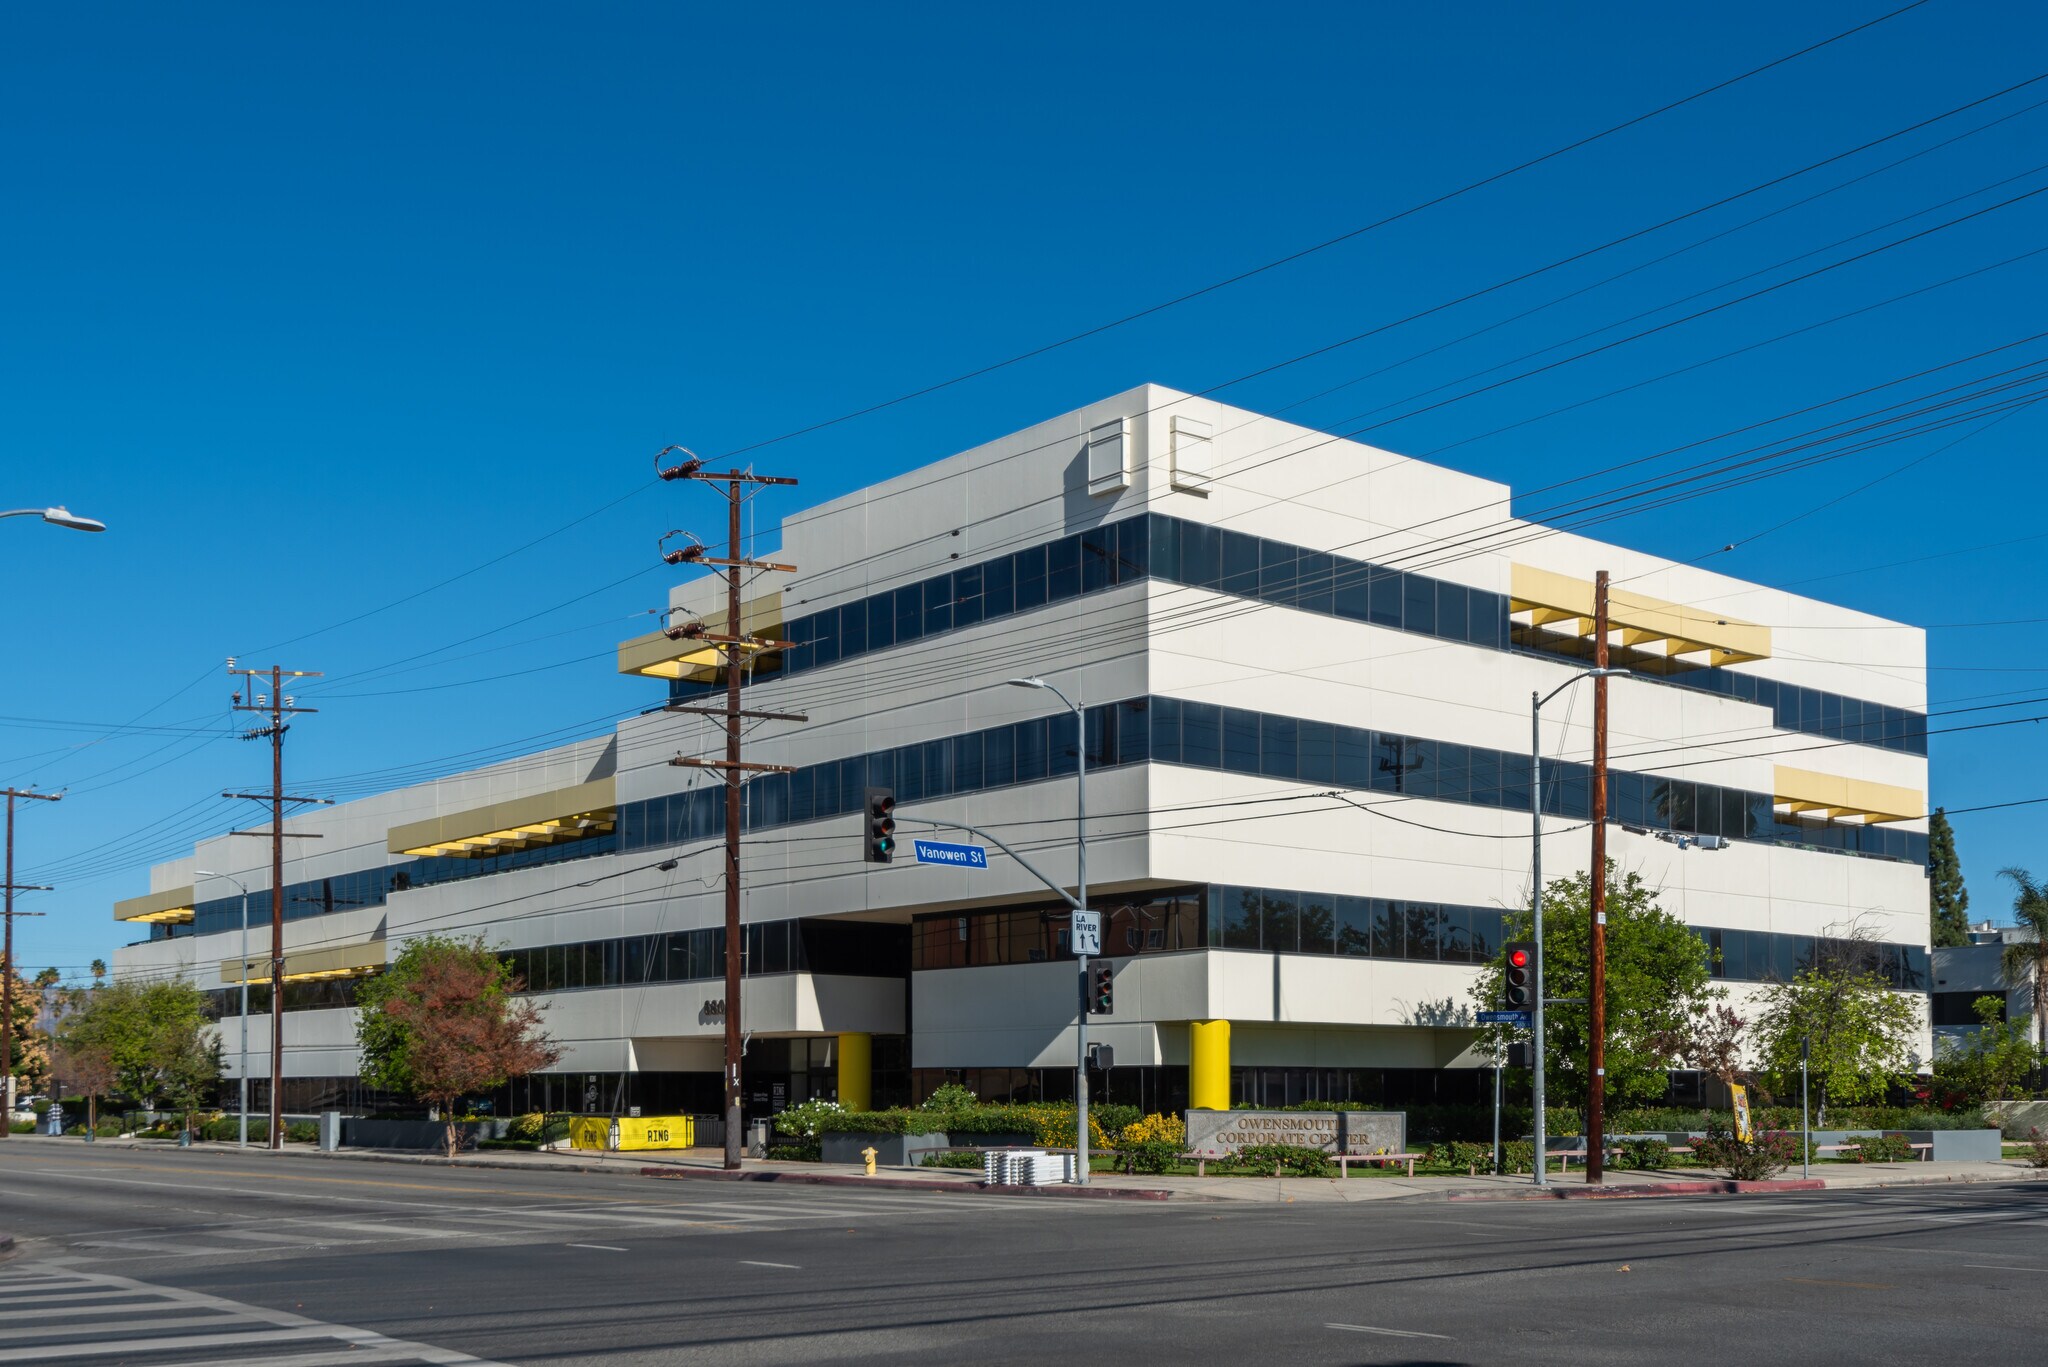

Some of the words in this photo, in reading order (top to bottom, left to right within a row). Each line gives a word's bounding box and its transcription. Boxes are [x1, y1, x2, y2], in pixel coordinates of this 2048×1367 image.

[919, 846, 967, 861] Vanowen
[970, 851, 983, 863] St
[1076, 915, 1086, 923] LA
[1076, 924, 1097, 932] RIVER
[647, 1129, 669, 1142] RING
[1216, 1132, 1305, 1145] CORPORATE
[1309, 1133, 1370, 1146] CENER
